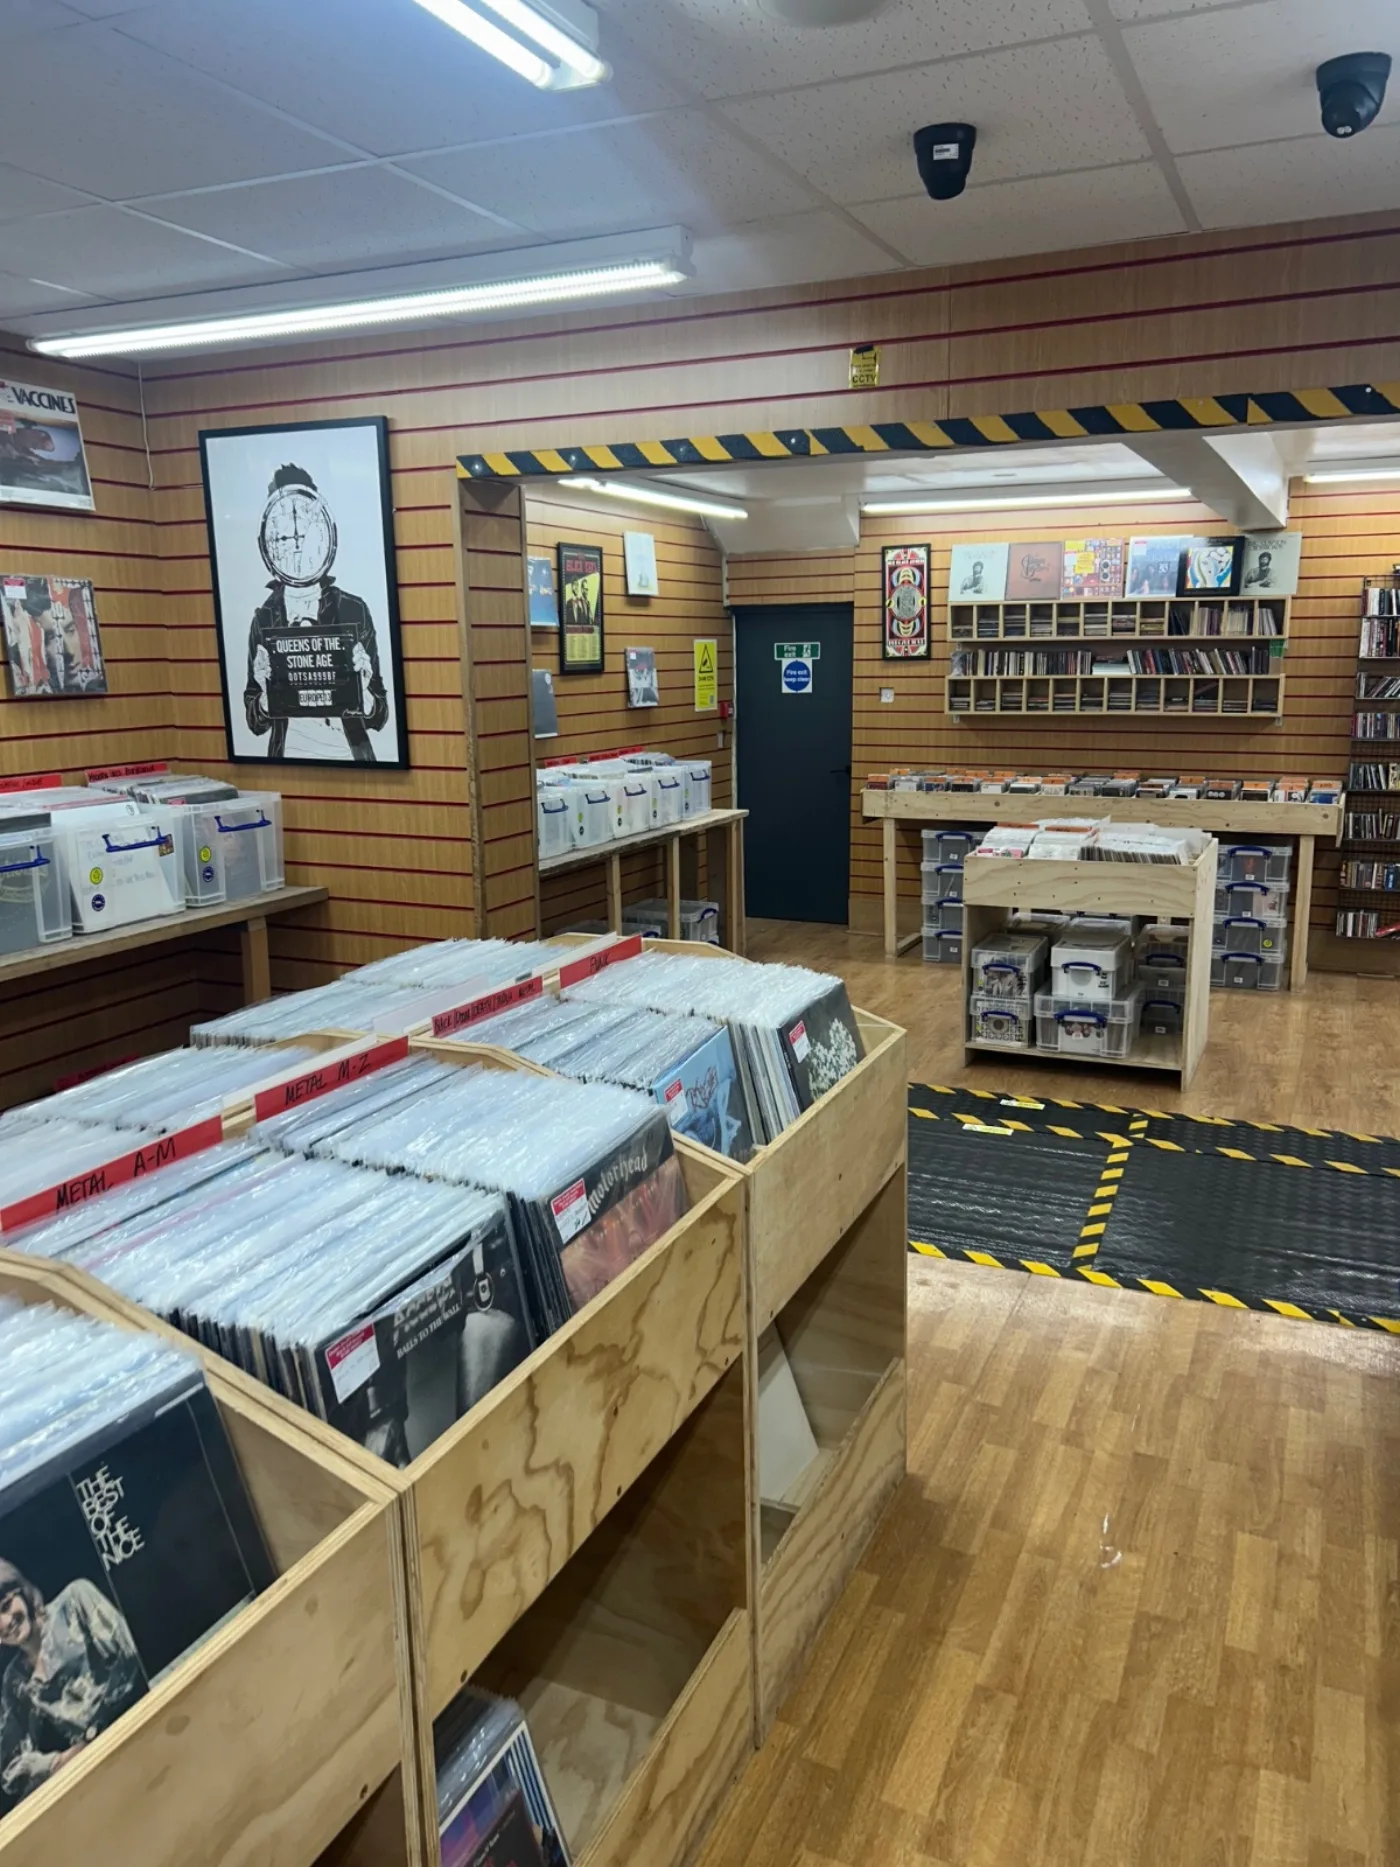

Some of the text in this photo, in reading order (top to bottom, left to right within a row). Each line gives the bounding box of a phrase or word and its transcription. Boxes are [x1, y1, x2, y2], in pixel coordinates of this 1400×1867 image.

[852, 374, 877, 384] CCTV
[12, 386, 76, 414] VACCINES
[276, 637, 341, 653] QUEENS OF THE
[286, 654, 334, 669] STONE AGE
[783, 644, 797, 652] Fire
[285, 1075, 327, 1106] METAL
[55, 1137, 177, 1214] METAL A-M
[397, 1303, 460, 1360] BALLS TO THE WALL
[76, 1465, 110, 1501] THE
[82, 1476, 124, 1519] BEST
[91, 1503, 115, 1539] OF
[95, 1515, 130, 1556] THE
[102, 1527, 146, 1571] NICE
